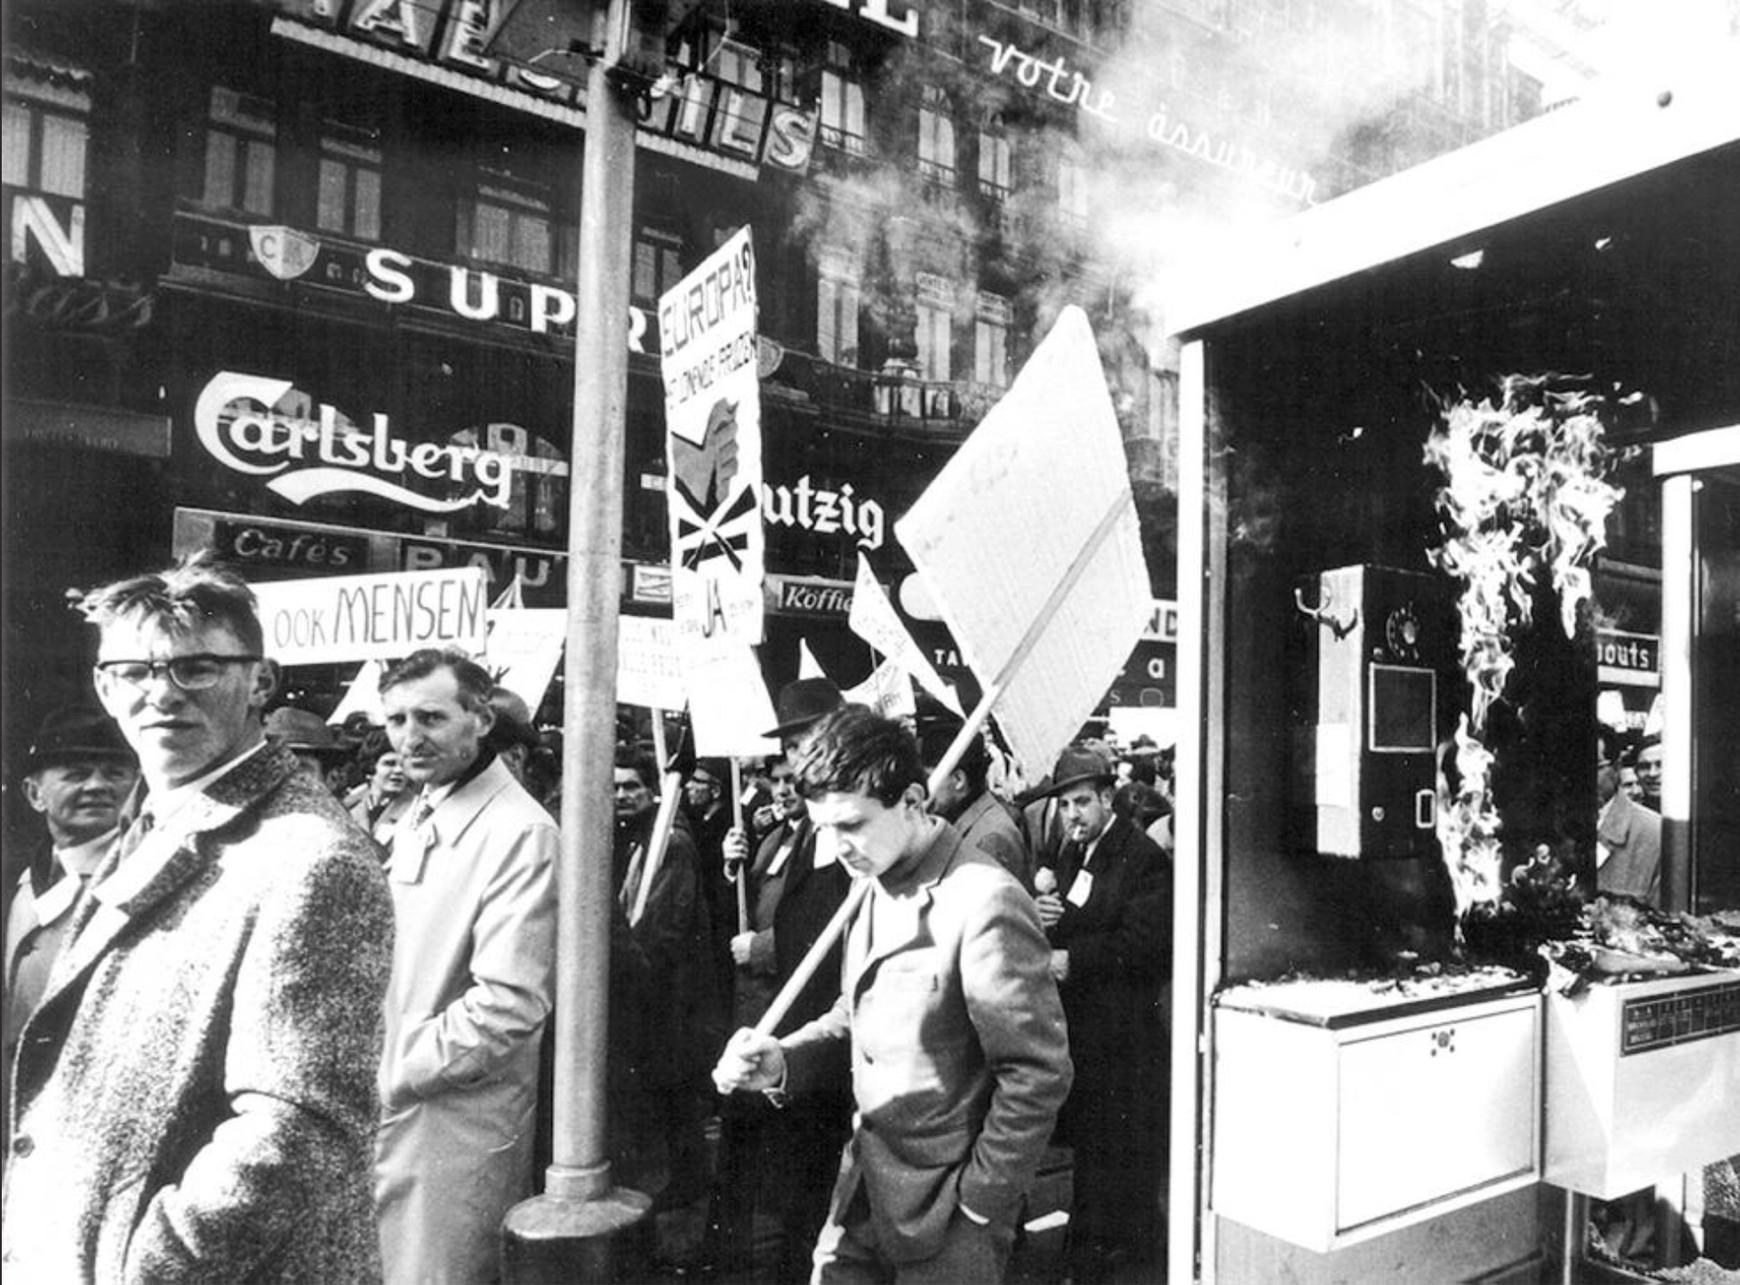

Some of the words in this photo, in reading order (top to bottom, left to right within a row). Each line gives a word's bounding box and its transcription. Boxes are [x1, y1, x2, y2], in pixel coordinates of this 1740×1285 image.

[978, 34, 1119, 124] votre
[195, 370, 511, 509] Carlsberg
[234, 528, 351, 566] Cafés
[274, 609, 325, 649] OOK
[334, 578, 485, 645] MENSEN
[702, 578, 727, 639] JA
[934, 648, 967, 667] TA
